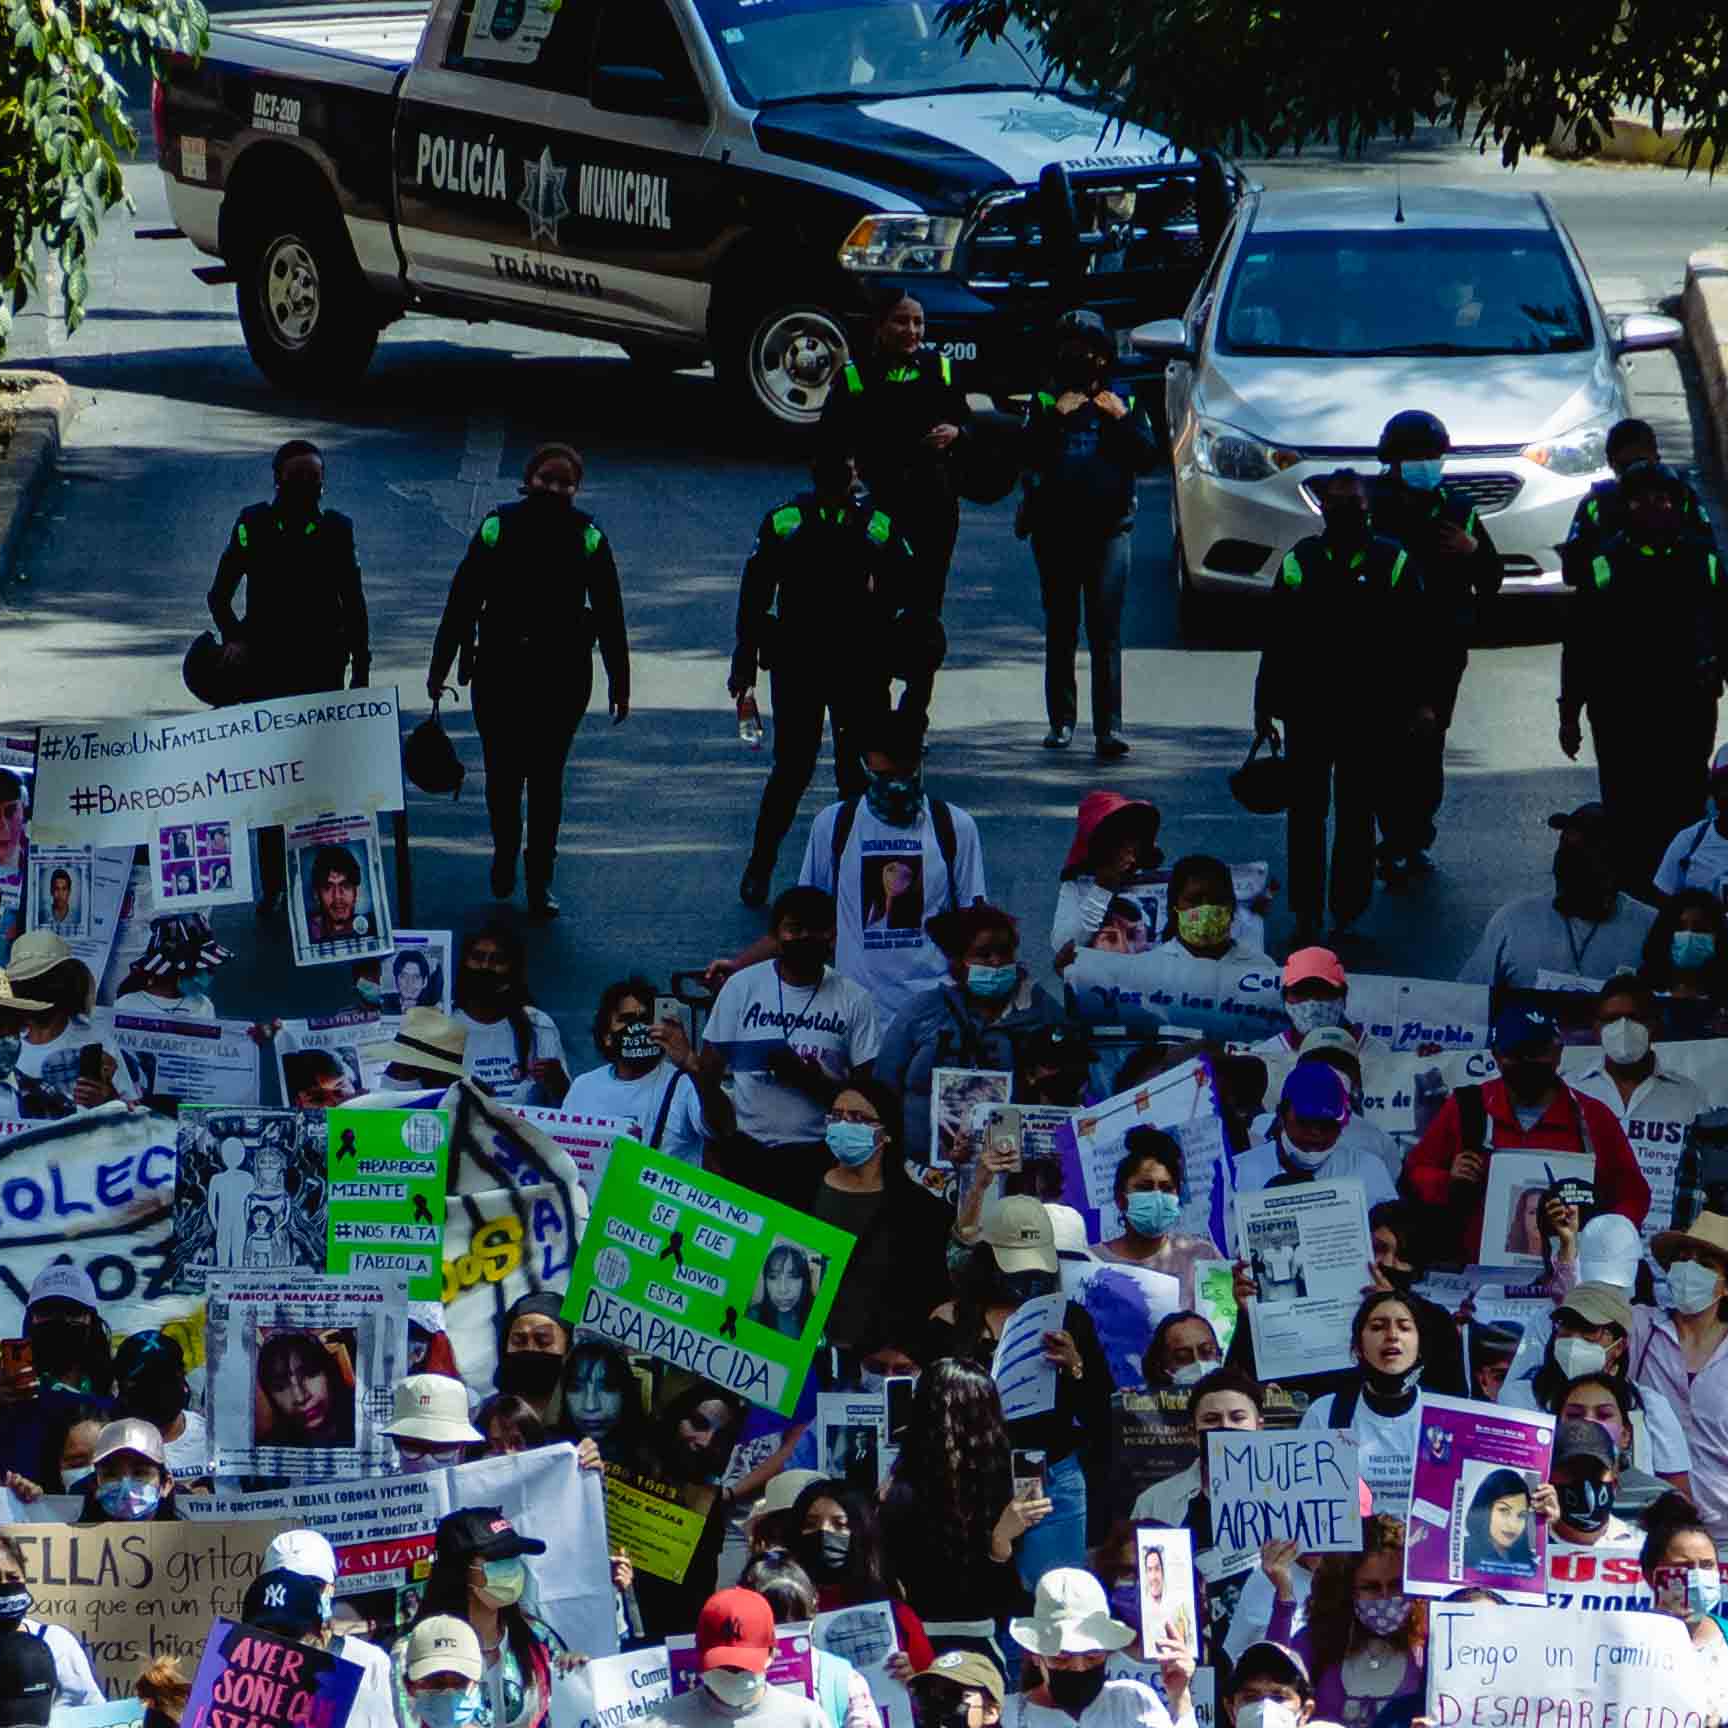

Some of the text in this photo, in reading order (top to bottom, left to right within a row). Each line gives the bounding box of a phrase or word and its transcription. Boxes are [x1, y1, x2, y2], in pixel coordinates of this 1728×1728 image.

[253, 91, 301, 122] DCT-200
[416, 133, 672, 230] POLICÍA MUNICIPAL
[491, 252, 601, 296] TRÁNSITO
[357, 1159, 437, 1175] #BARBOSA
[332, 1183, 405, 1197] MIENTE
[652, 1203, 676, 1225] SE
[687, 1188, 749, 1225] HIJA NO
[335, 1224, 438, 1241] #NOS FALTA
[607, 1218, 656, 1252] CON EL
[695, 1227, 728, 1252] FUE
[353, 1254, 429, 1273] FABIOLA
[676, 1266, 720, 1291] NOVIO
[647, 1283, 684, 1309] ESTA
[583, 1293, 770, 1400] DESAPARECIDA
[1223, 1441, 1349, 1494] MUJER
[188, 1501, 213, 1513] Viva
[380, 1481, 429, 1499] VICTORIA
[85, 1600, 129, 1626] que
[136, 1599, 165, 1617] en
[230, 1636, 304, 1684] AYER
[1437, 1612, 1574, 1686] Tengo un
